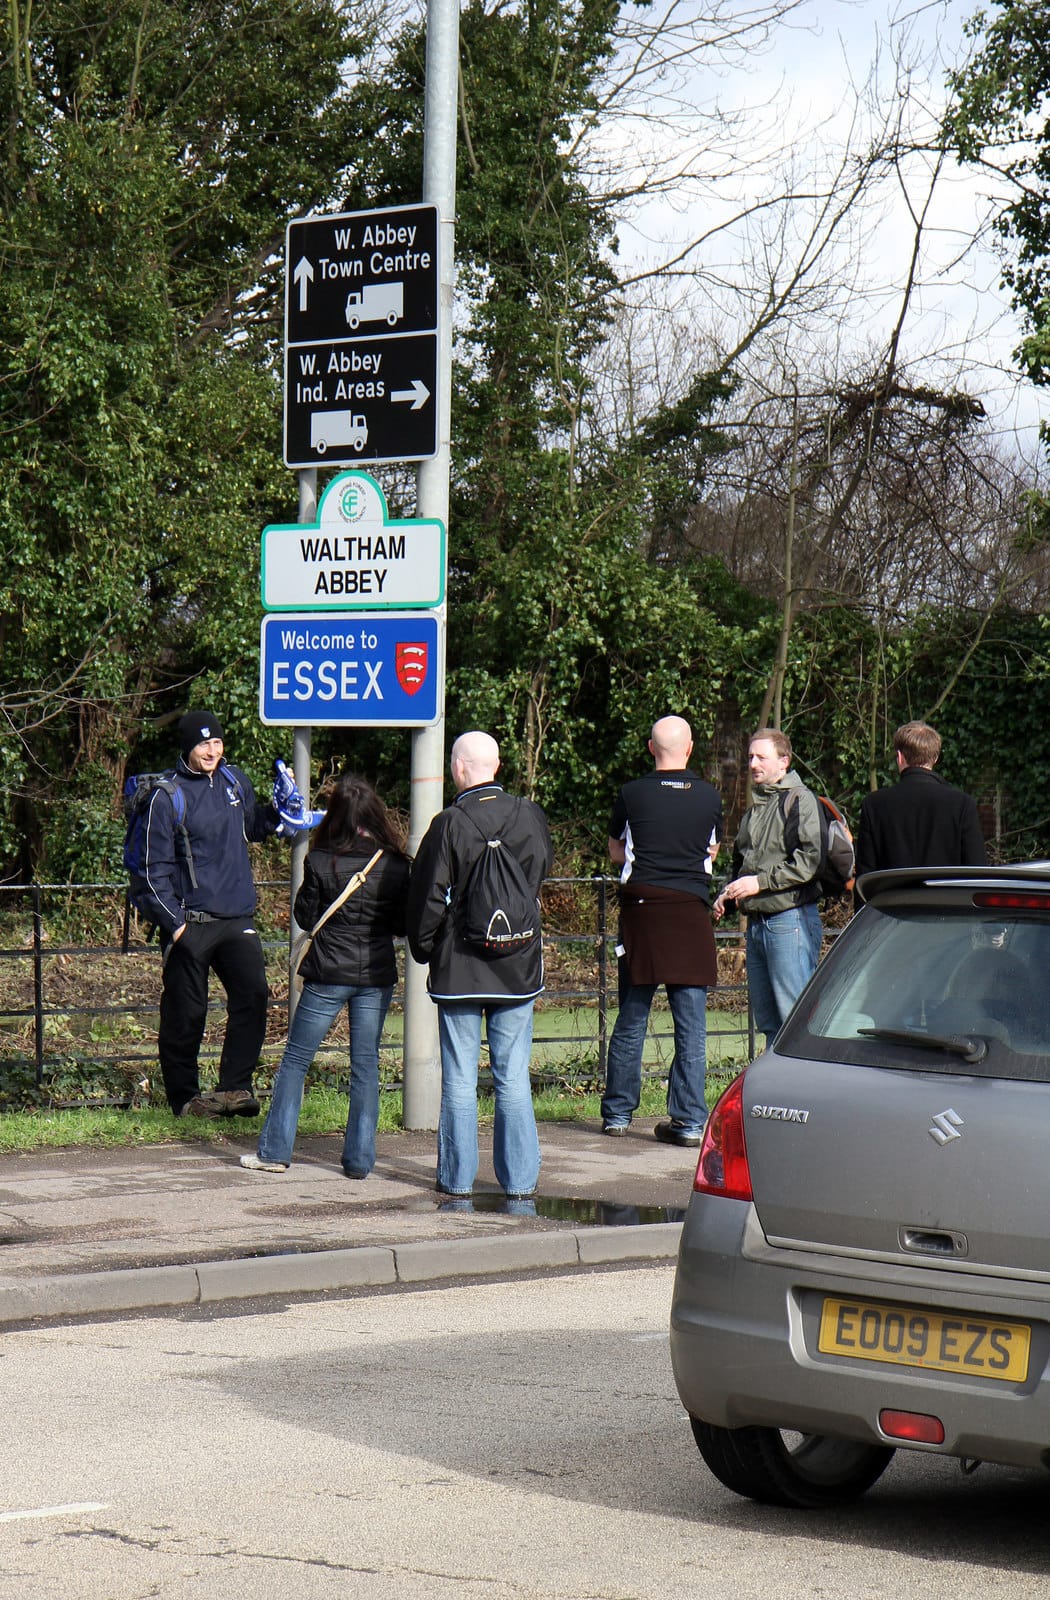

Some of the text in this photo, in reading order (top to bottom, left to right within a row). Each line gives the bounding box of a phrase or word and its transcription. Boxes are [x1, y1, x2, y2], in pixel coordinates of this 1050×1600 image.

[334, 224, 417, 250] W. Abbey
[319, 250, 431, 280] Town Centre
[300, 351, 382, 376] W. Abbey
[296, 379, 385, 403] Ind. Areas
[300, 535, 406, 562] WALTHAM
[314, 569, 388, 595] ABBEY
[281, 630, 378, 650] Welcome to
[272, 660, 384, 701] ESSEX
[488, 929, 534, 942] HEAD
[750, 1105, 810, 1124] SUZUKI
[939, 1319, 1012, 1370] EZS
